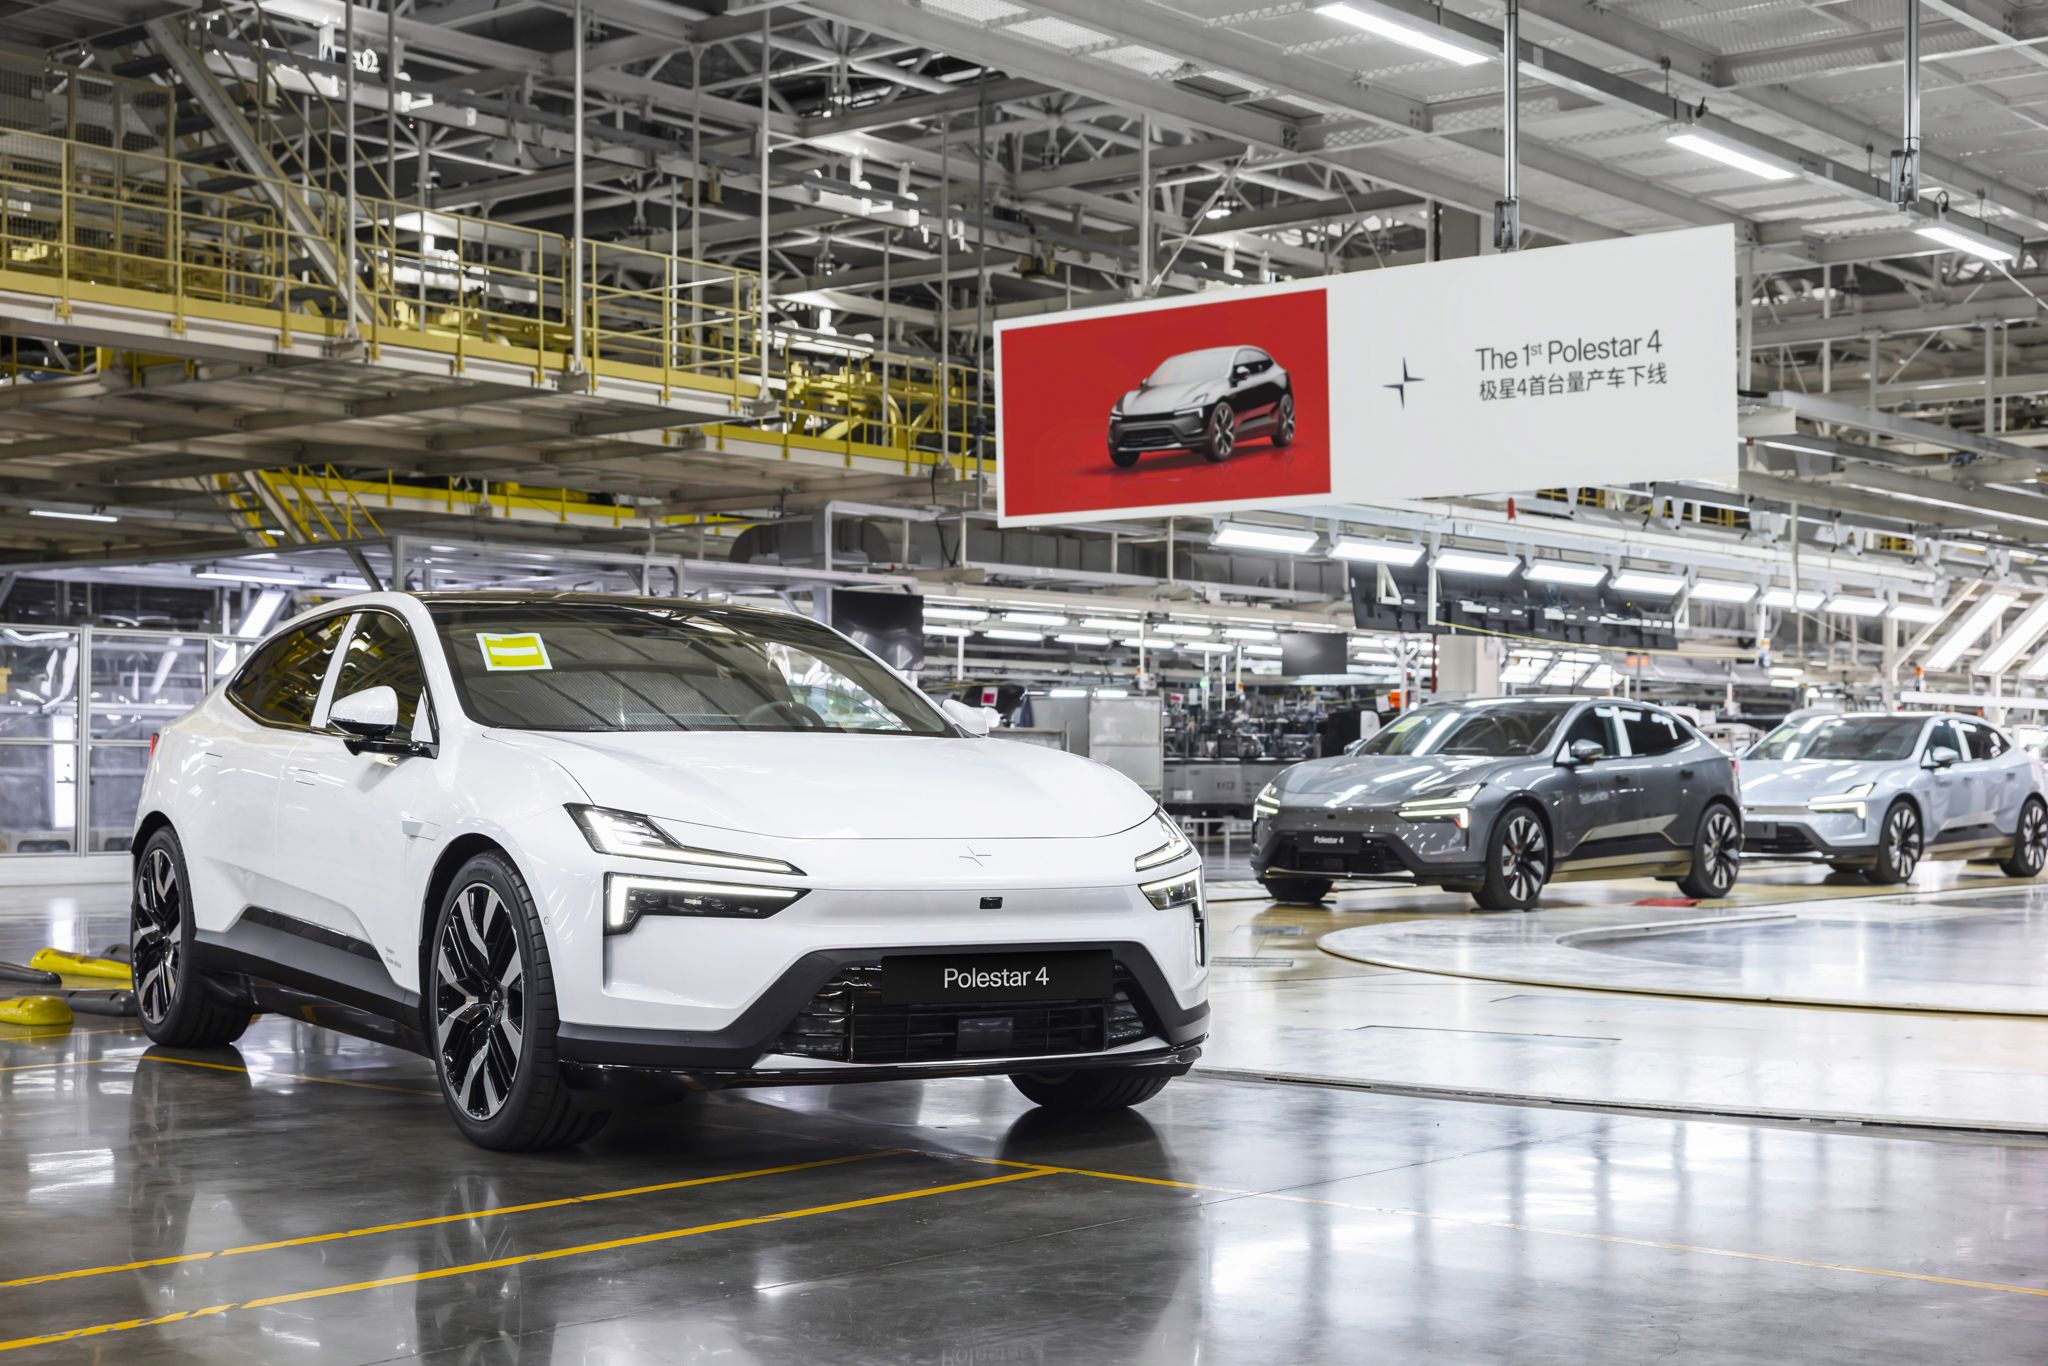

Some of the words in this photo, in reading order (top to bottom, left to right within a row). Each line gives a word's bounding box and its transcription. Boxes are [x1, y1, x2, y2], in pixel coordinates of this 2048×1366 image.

[1475, 348, 1518, 371] The
[1548, 337, 1643, 364] Polestar
[1646, 329, 1663, 353] 4
[1479, 363, 1667, 401] 极星4首台量产车下线
[1313, 835, 1338, 844] Poltr
[944, 967, 1031, 988] Polestar
[1035, 966, 1049, 986] 4
